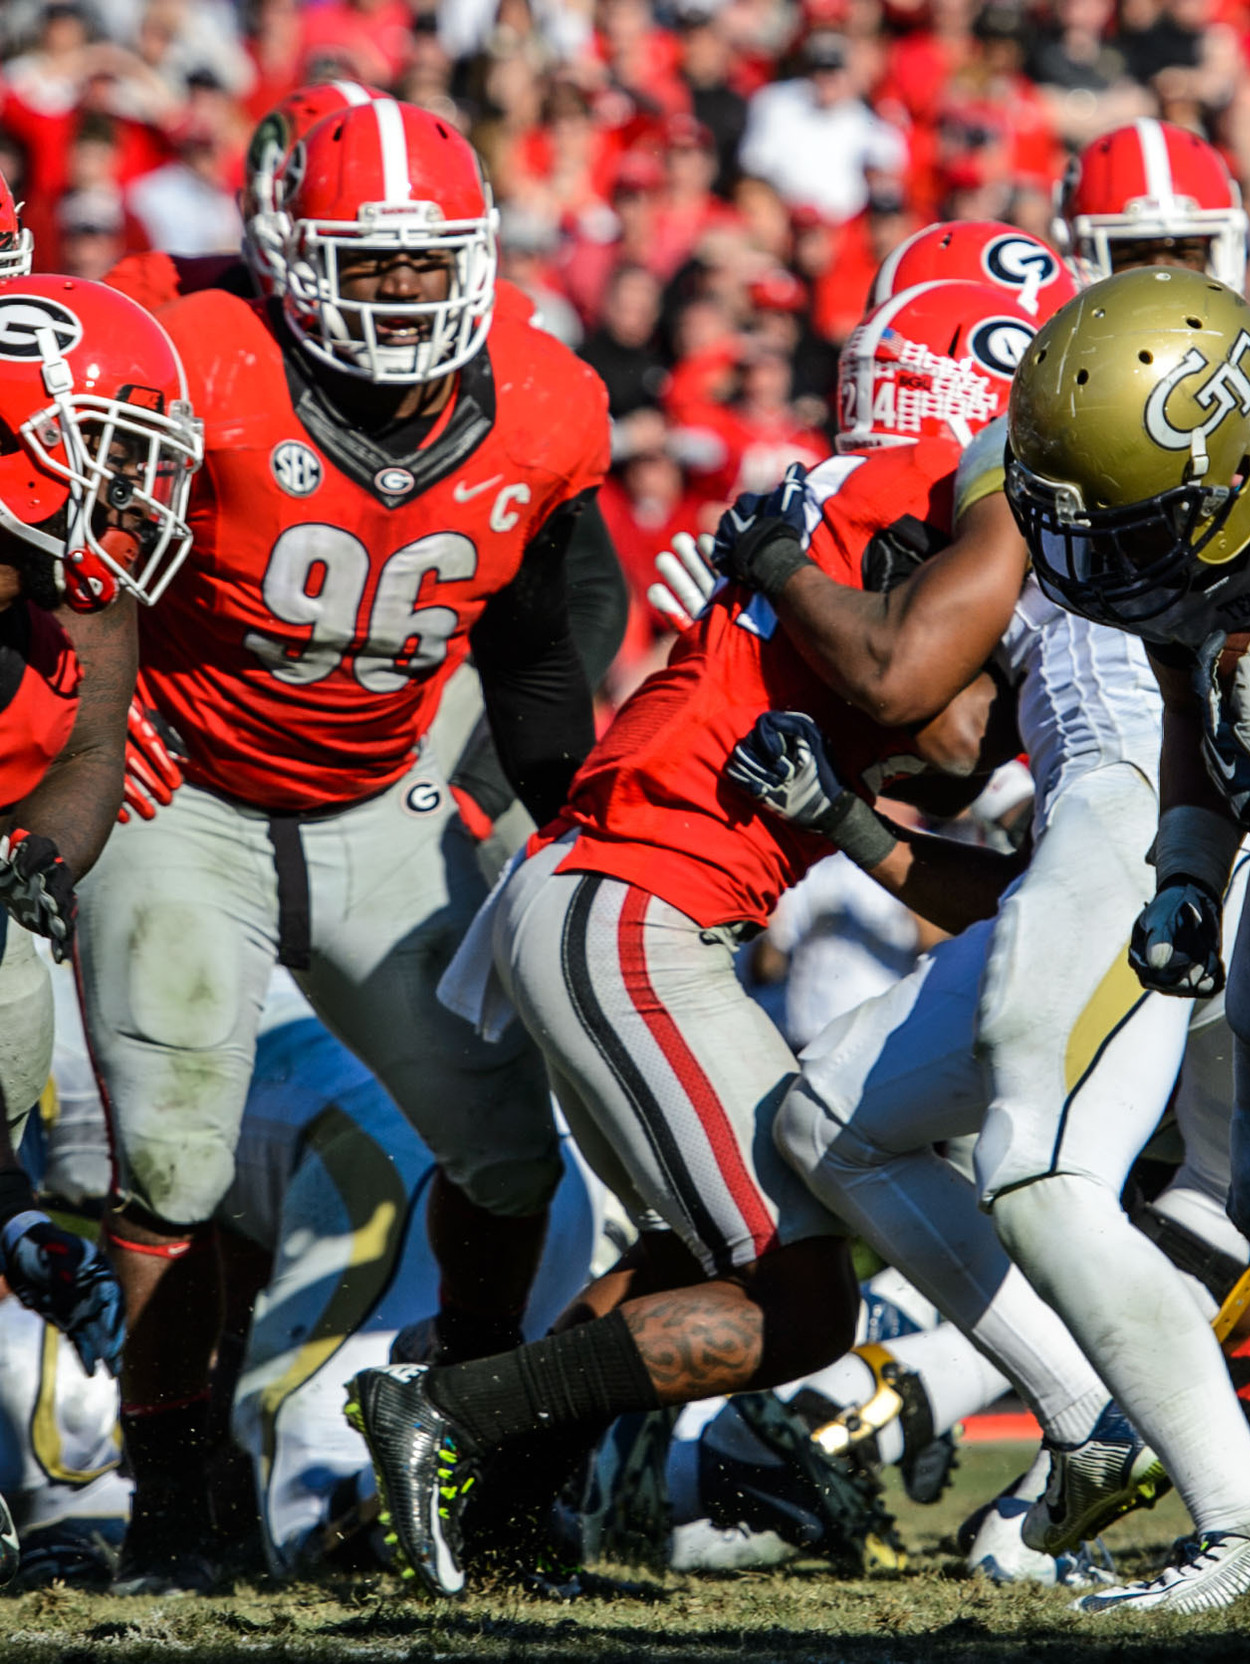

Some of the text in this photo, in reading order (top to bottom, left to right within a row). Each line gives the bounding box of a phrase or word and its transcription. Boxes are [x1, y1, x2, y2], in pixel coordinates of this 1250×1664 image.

[990, 237, 1055, 283] G
[272, 441, 321, 495] SEC
[377, 470, 413, 493] G
[490, 483, 531, 533] C
[243, 522, 477, 694] 96
[405, 781, 442, 814] G
